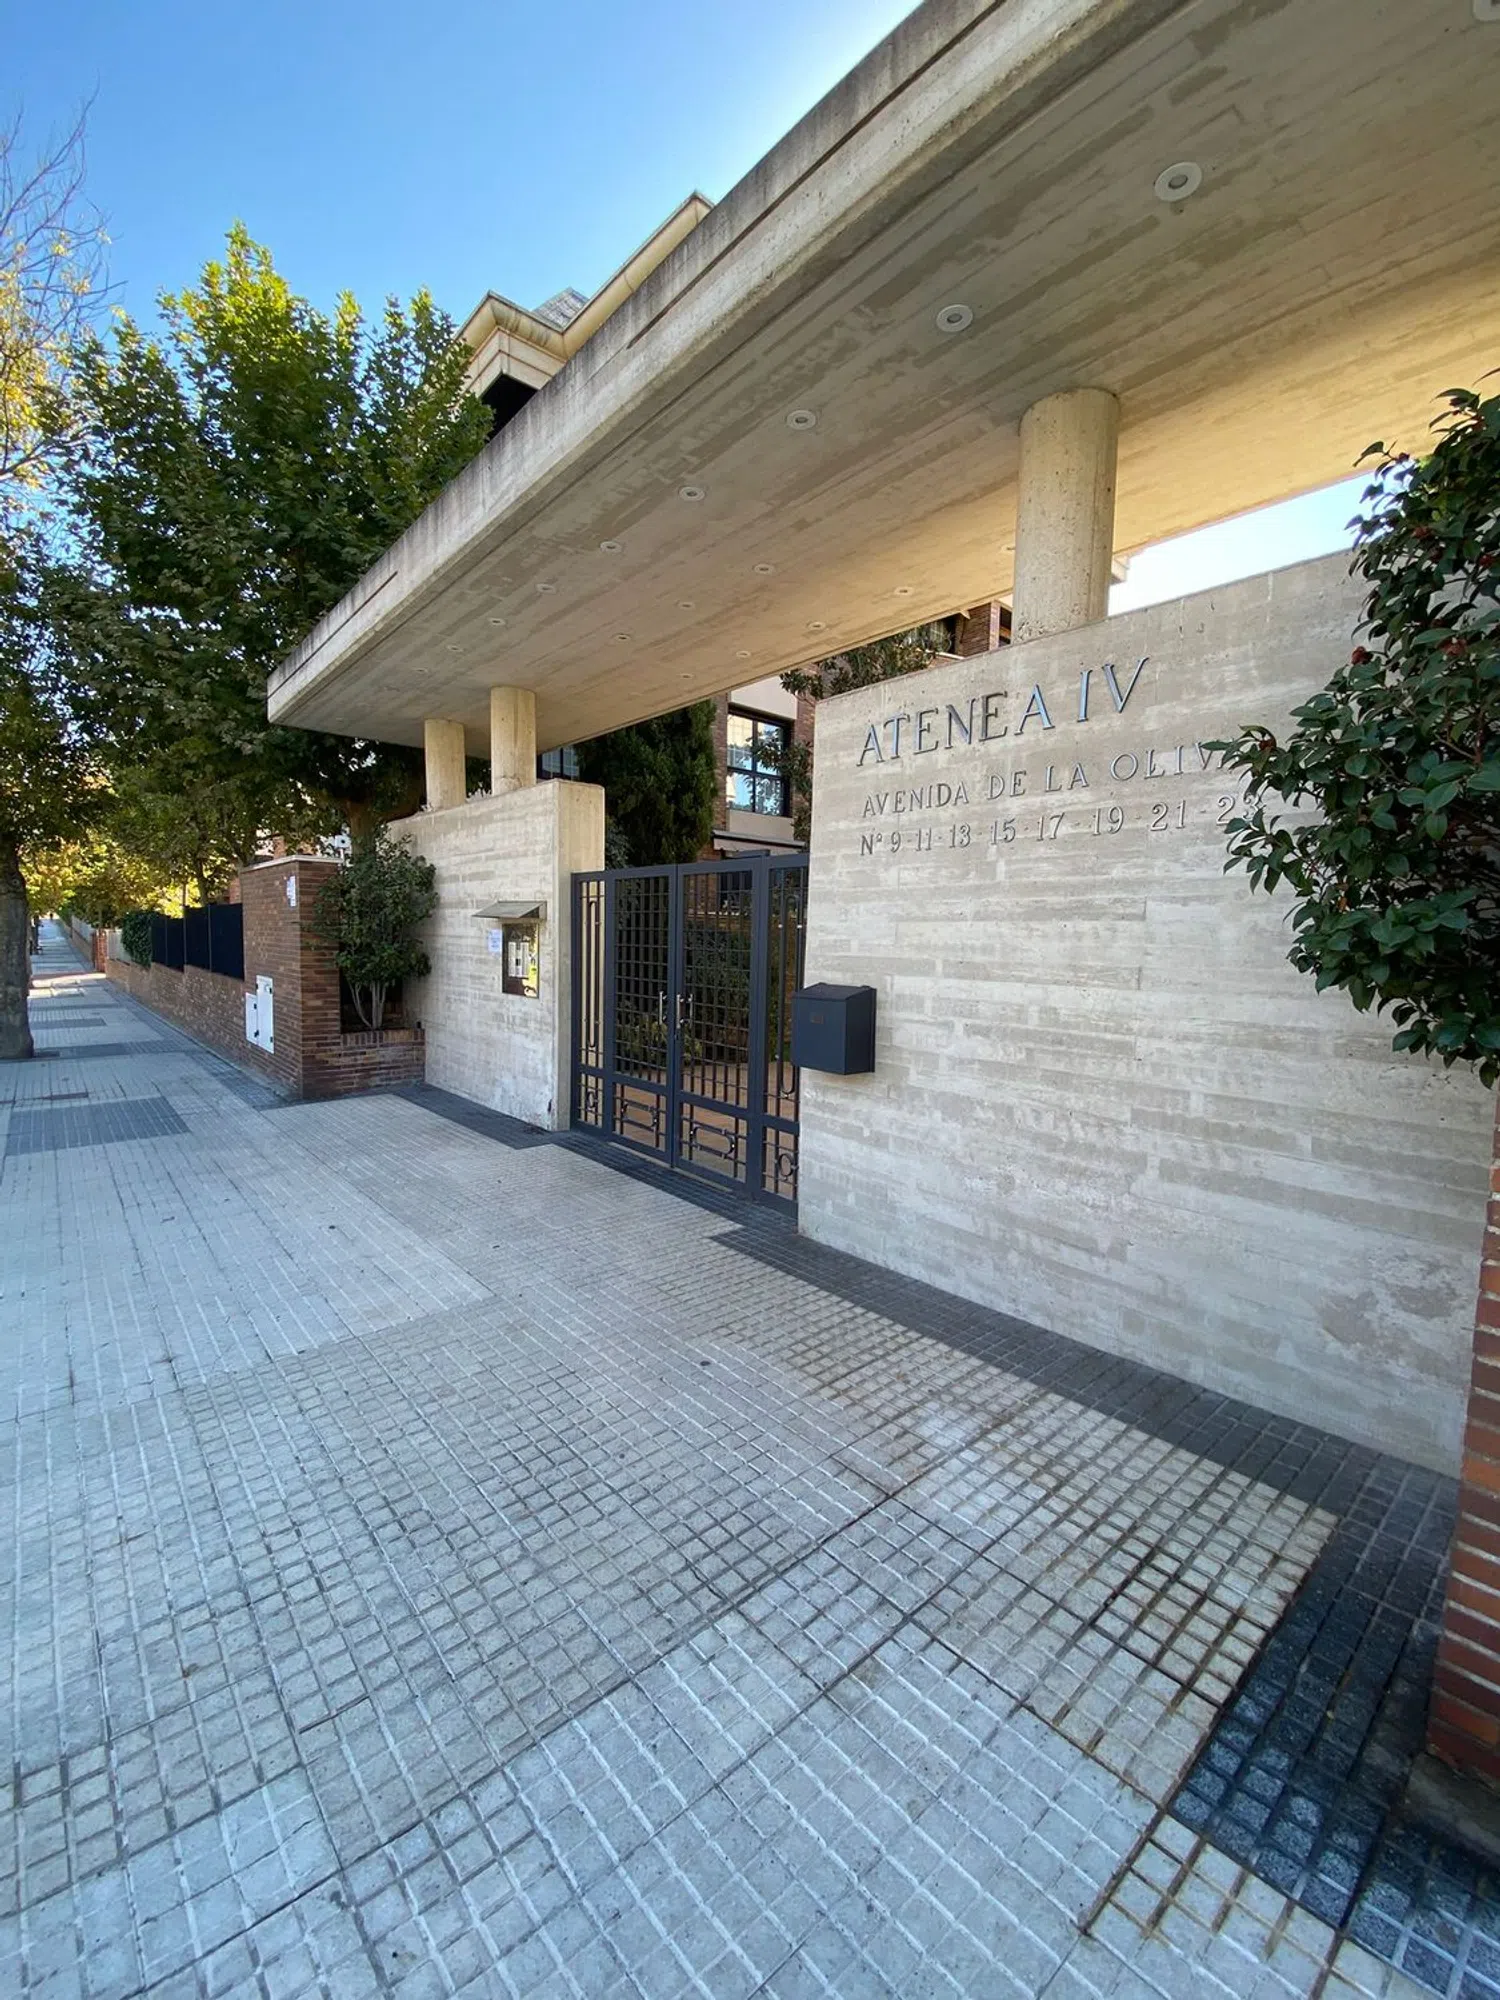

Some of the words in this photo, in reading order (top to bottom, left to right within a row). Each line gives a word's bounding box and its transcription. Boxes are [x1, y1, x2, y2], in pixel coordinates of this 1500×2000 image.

[856, 684, 1055, 767] ATENEA
[1076, 656, 1150, 723] IV
[862, 781, 970, 818] AVENIDA
[987, 770, 1027, 801] DE
[1044, 762, 1089, 793] LA
[1110, 741, 1225, 781] OLIV
